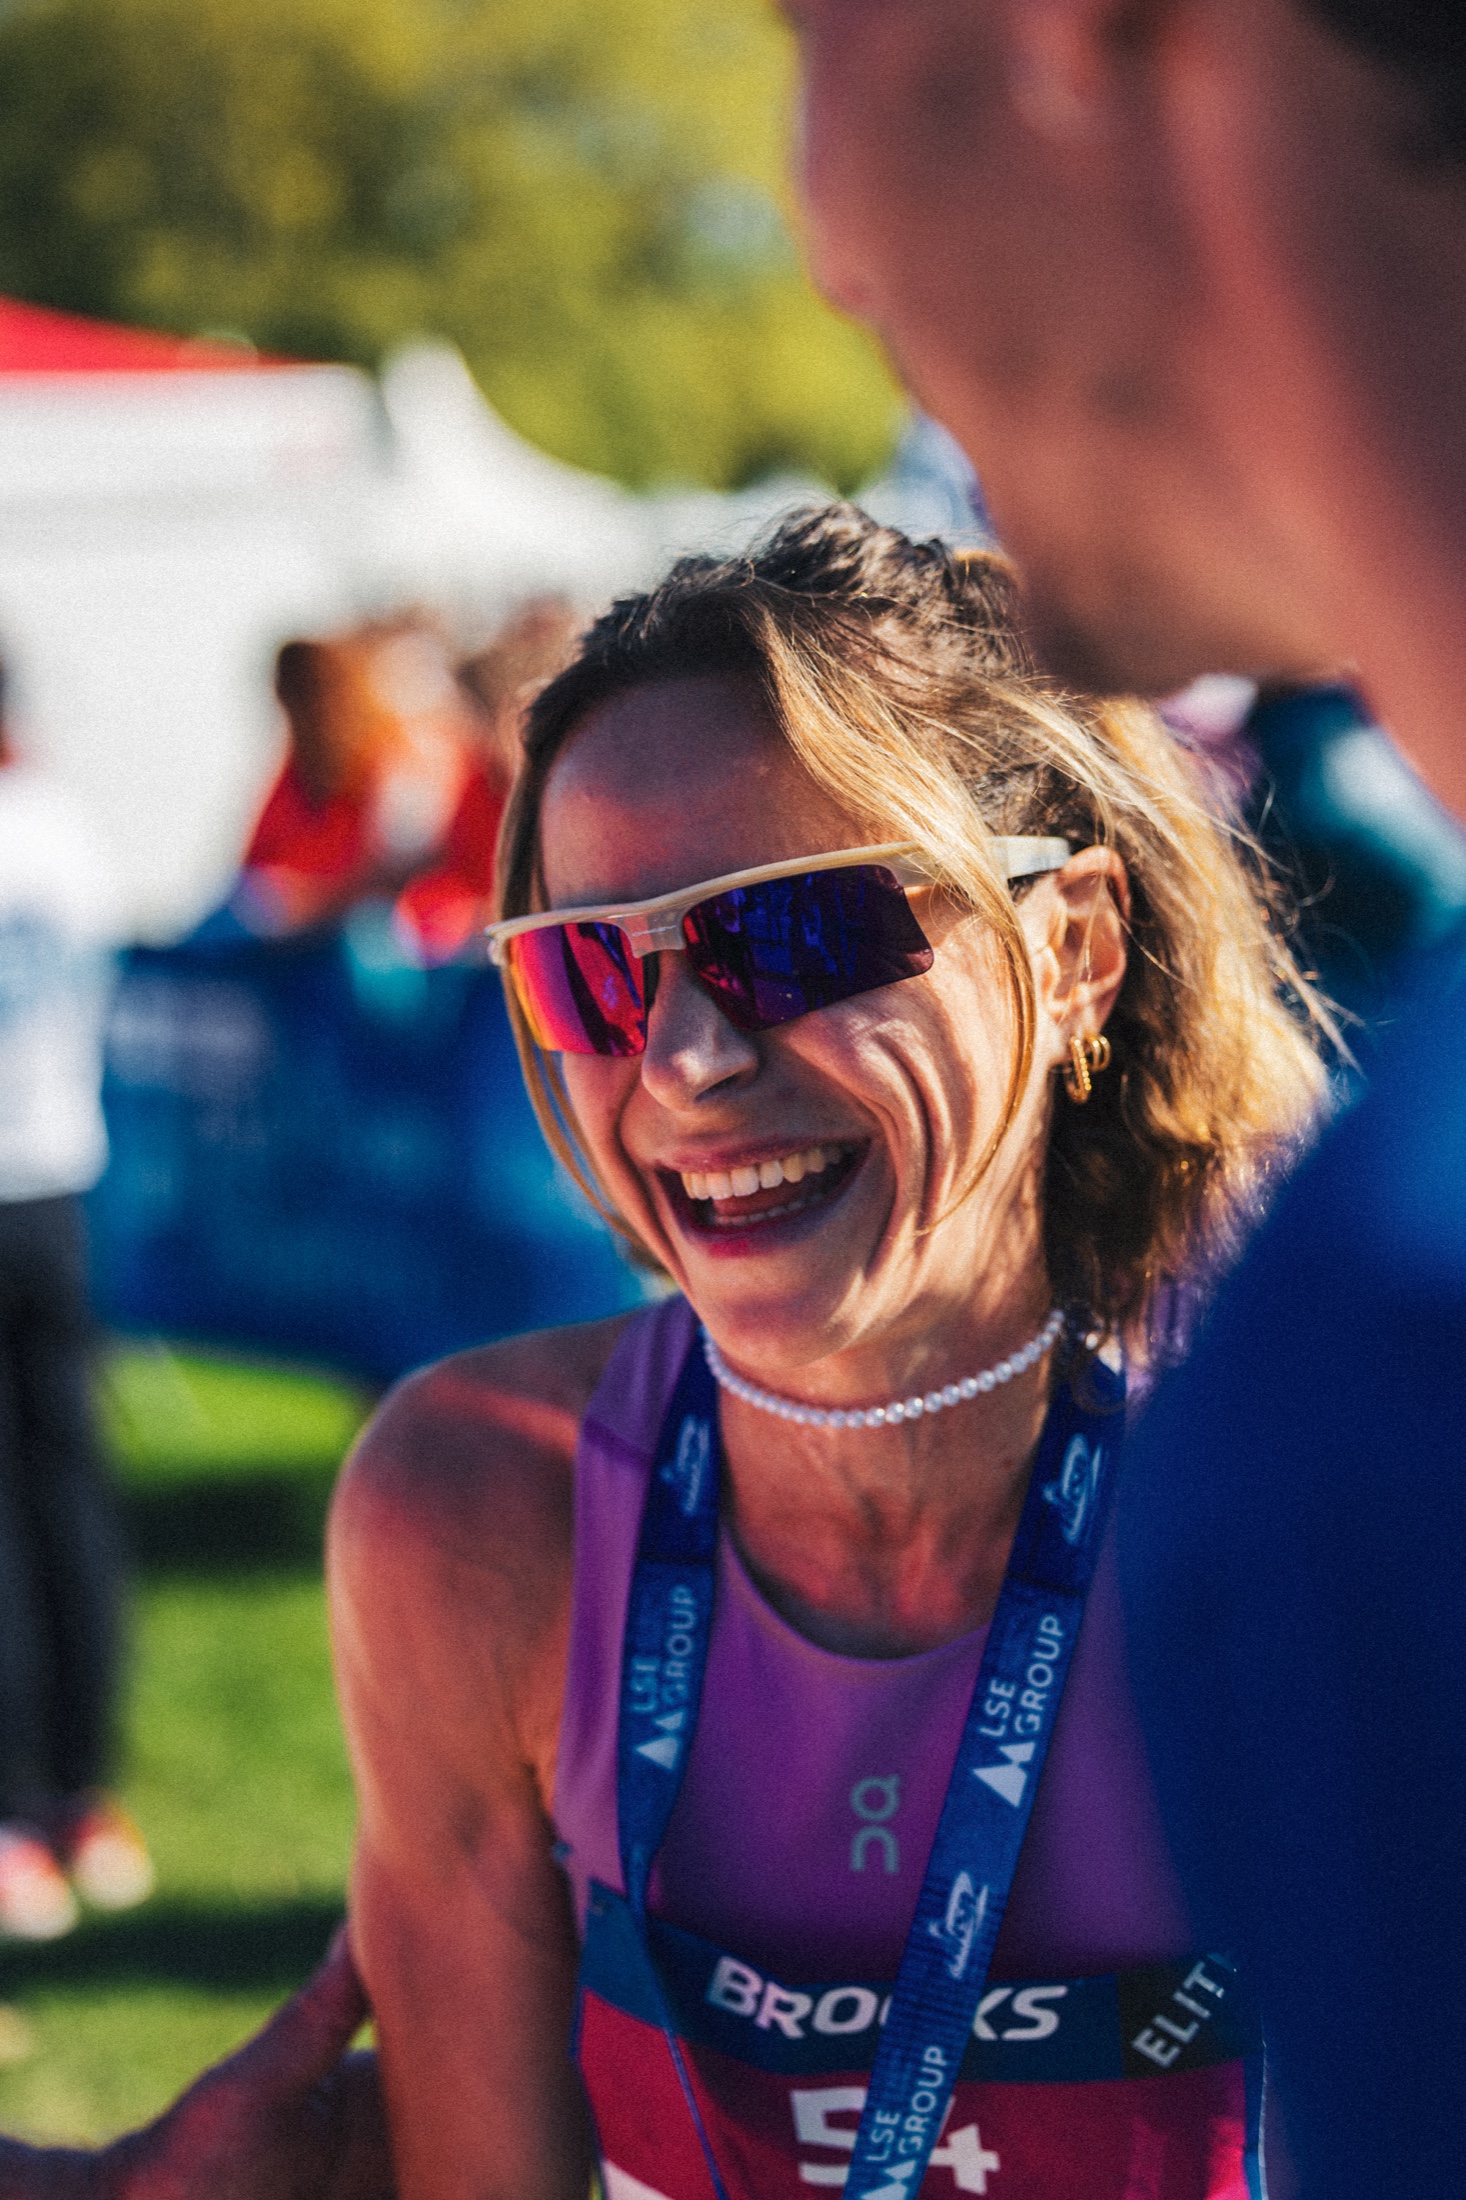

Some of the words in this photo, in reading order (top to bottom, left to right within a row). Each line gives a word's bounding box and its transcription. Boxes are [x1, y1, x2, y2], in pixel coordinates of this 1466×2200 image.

[979, 1679, 1016, 1739] LSE
[1013, 1613, 1067, 1736] GROUP
[704, 1956, 1069, 2041] BROKS
[866, 2110, 900, 2161] LSE
[898, 2045, 948, 2155] GROUP
